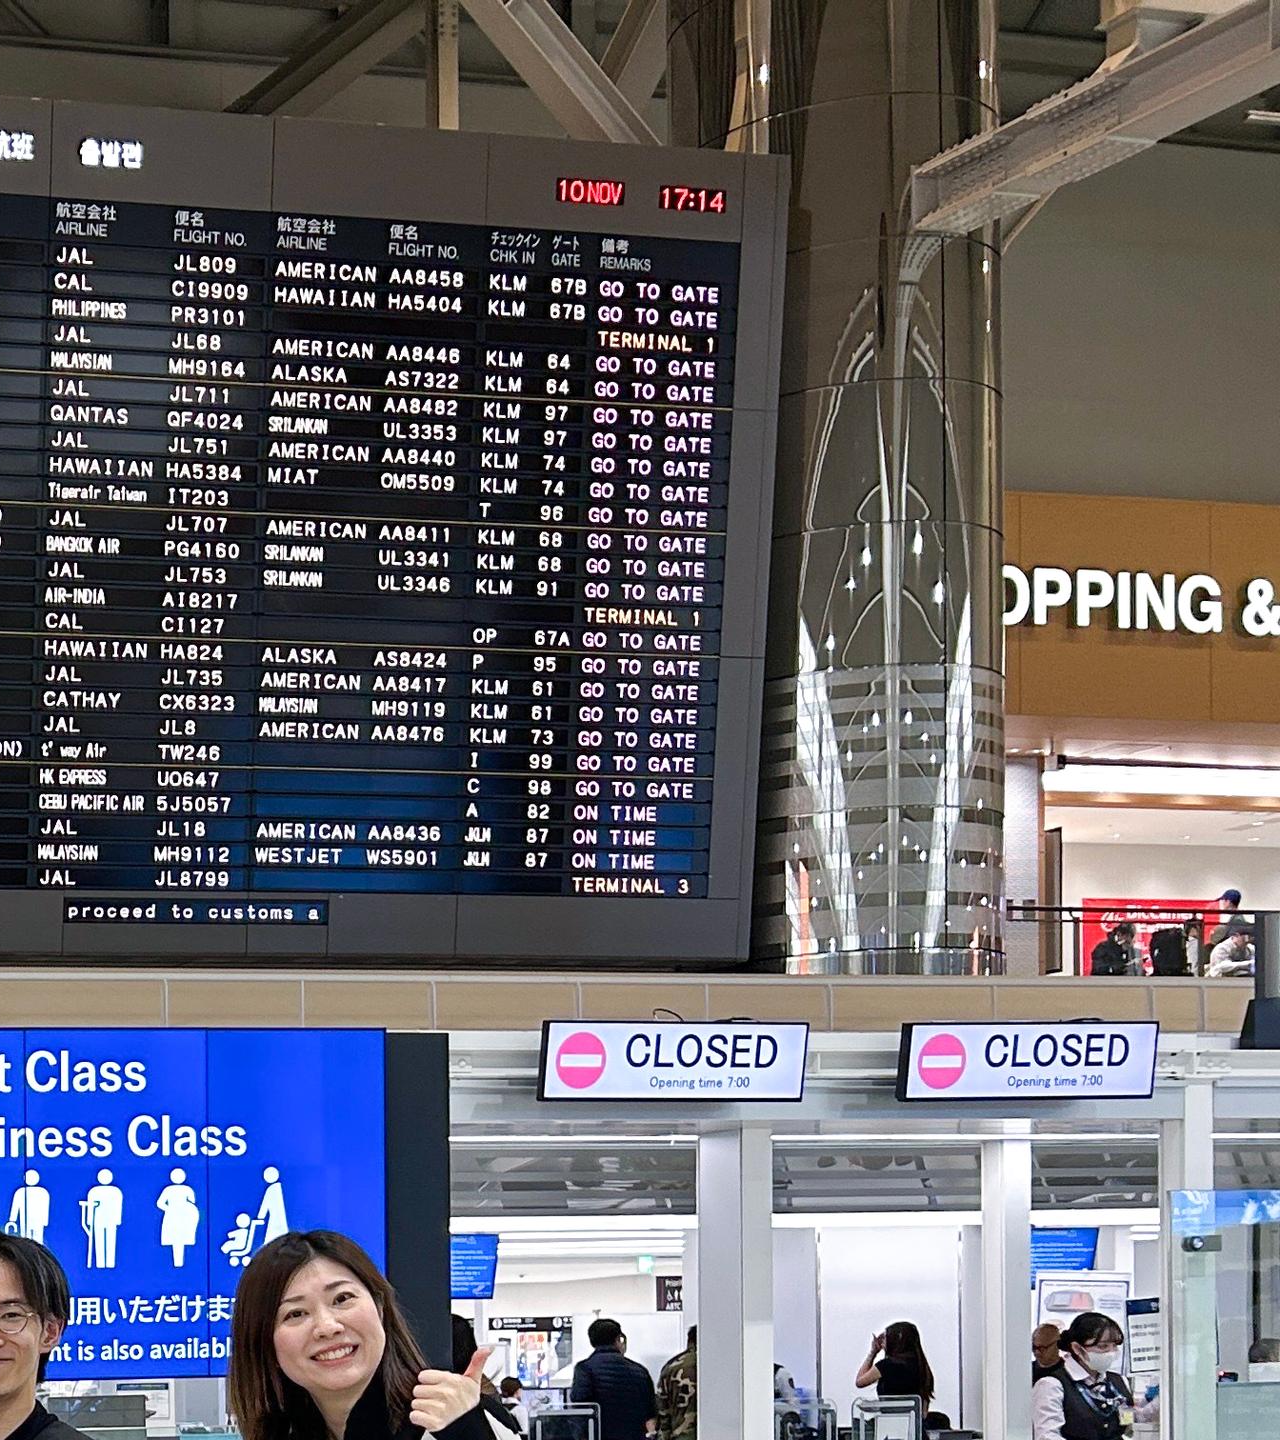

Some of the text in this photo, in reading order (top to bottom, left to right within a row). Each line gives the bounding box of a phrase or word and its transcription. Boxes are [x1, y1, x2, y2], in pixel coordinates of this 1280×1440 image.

[663, 188, 724, 213] 17:14
[44, 639, 148, 659] HAWAIIAN
[160, 643, 224, 661] HA824
[261, 647, 337, 665] ALASKA
[373, 650, 447, 669] AS8424
[472, 653, 485, 670] P
[533, 656, 557, 672] 95
[581, 657, 606, 674] GO
[617, 658, 642, 675] TO
[652, 660, 701, 677] GATE
[40, 818, 78, 835] JAL
[156, 820, 206, 837] JL18
[256, 822, 356, 840] AMERICAN
[367, 825, 441, 842] AA8436
[526, 828, 549, 844] 87
[572, 828, 598, 845] ON
[609, 829, 656, 847] TIME
[68, 903, 319, 920] proceed to customs a
[625, 1033, 778, 1068] CLOSED
[985, 1033, 1130, 1067] CLOSED
[25, 1050, 148, 1093] Class
[649, 1076, 750, 1089] Opening time 7:00
[1007, 1075, 1103, 1088] Opening time 7:00
[127, 1115, 248, 1158] Class
[78, 1340, 94, 1361] is
[100, 1339, 144, 1361] also
[150, 1337, 232, 1359] availabl
